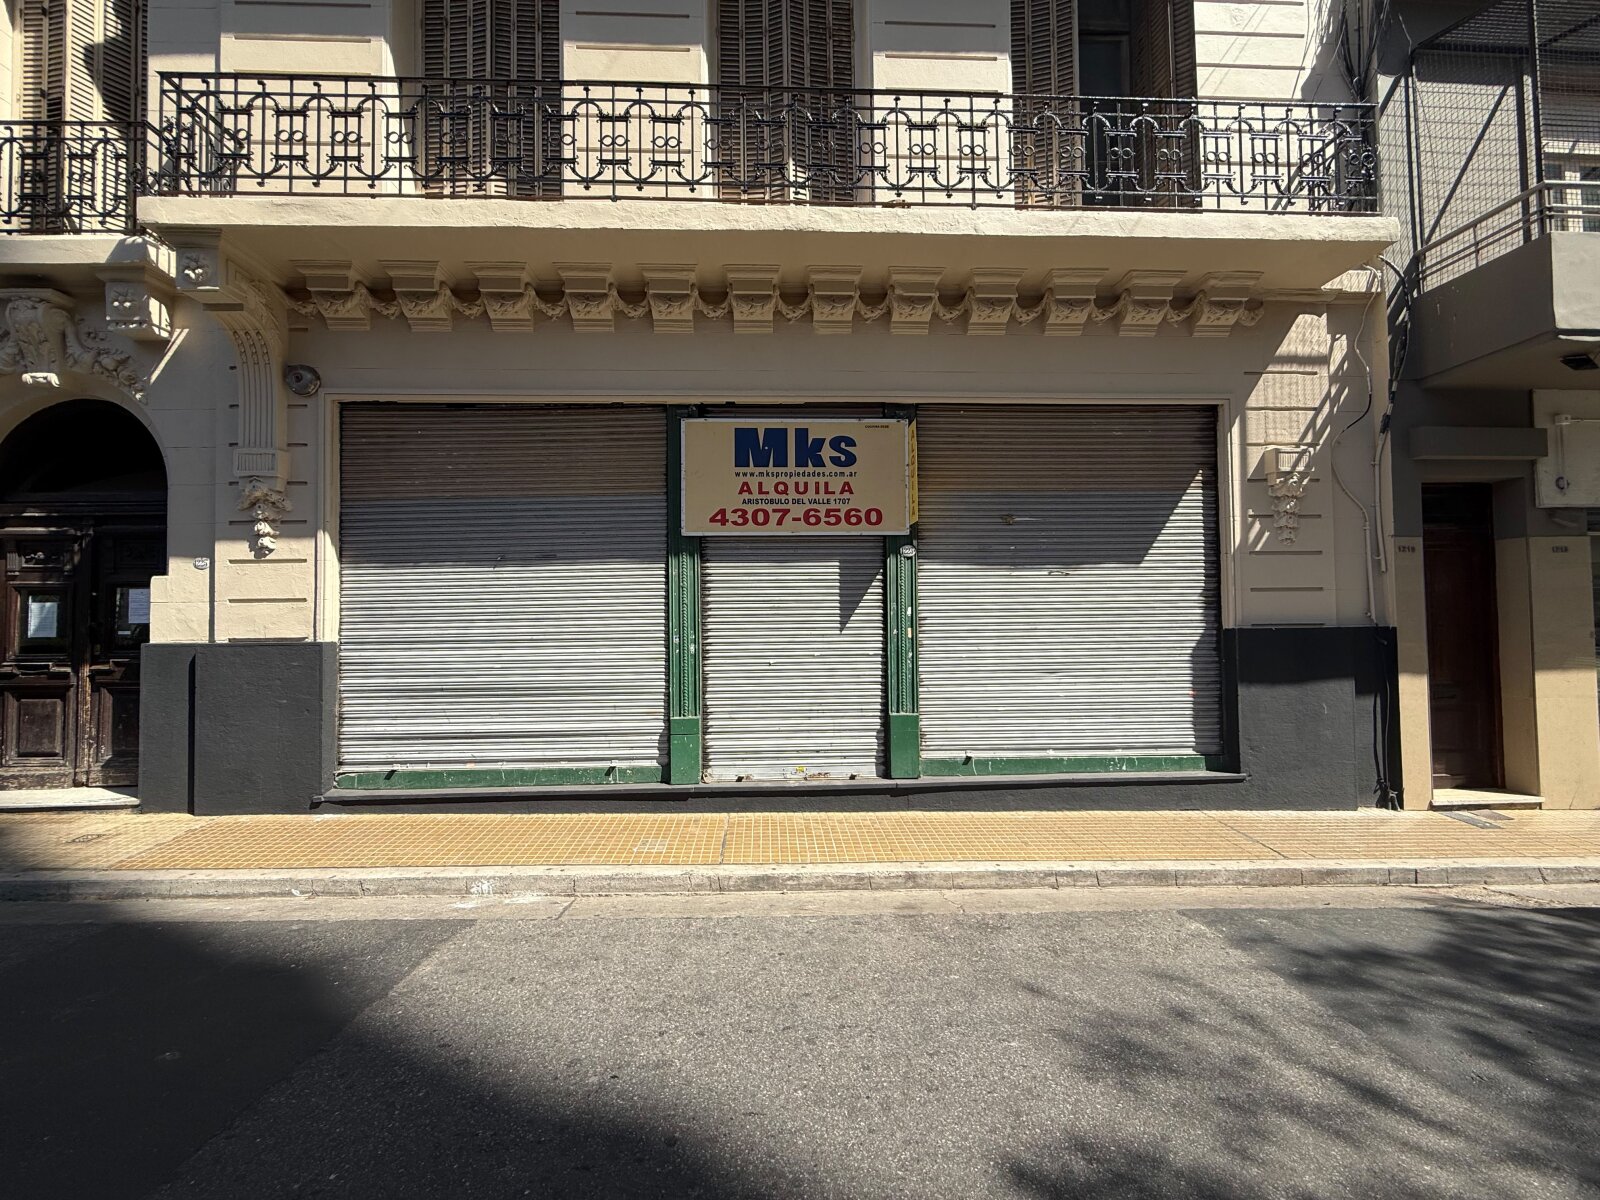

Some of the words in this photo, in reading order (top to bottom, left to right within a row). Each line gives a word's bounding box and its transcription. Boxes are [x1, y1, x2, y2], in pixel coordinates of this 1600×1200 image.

[734, 427, 857, 468] Mks
[734, 470, 857, 478] www.mkspropiedades.com.ar
[738, 481, 854, 496] ALQUILA
[708, 508, 883, 526] 4307-6560
